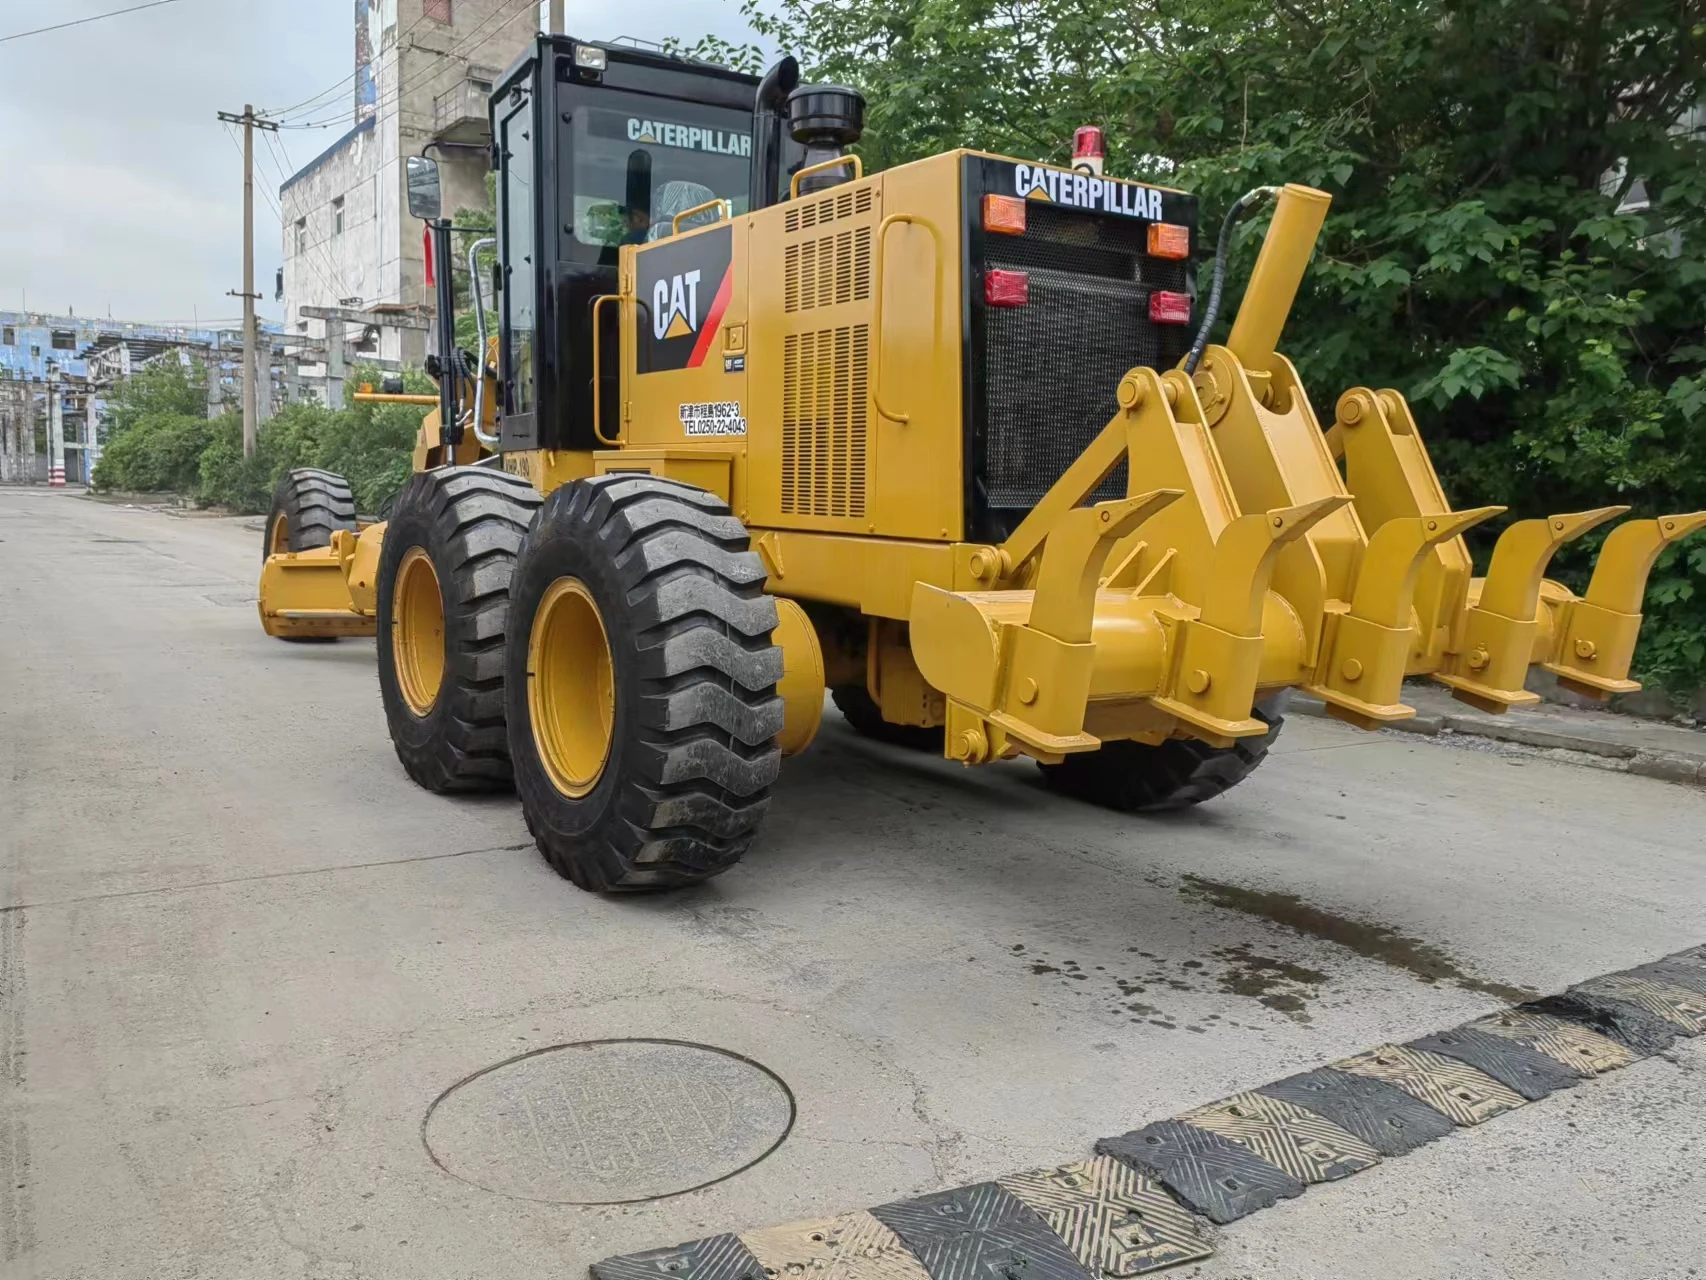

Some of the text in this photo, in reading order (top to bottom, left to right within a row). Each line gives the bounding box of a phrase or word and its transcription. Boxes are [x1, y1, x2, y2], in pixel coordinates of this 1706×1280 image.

[627, 117, 751, 157] CATERPILLAR
[1015, 163, 1163, 221] CATERPILLAR
[653, 268, 701, 340] CAT
